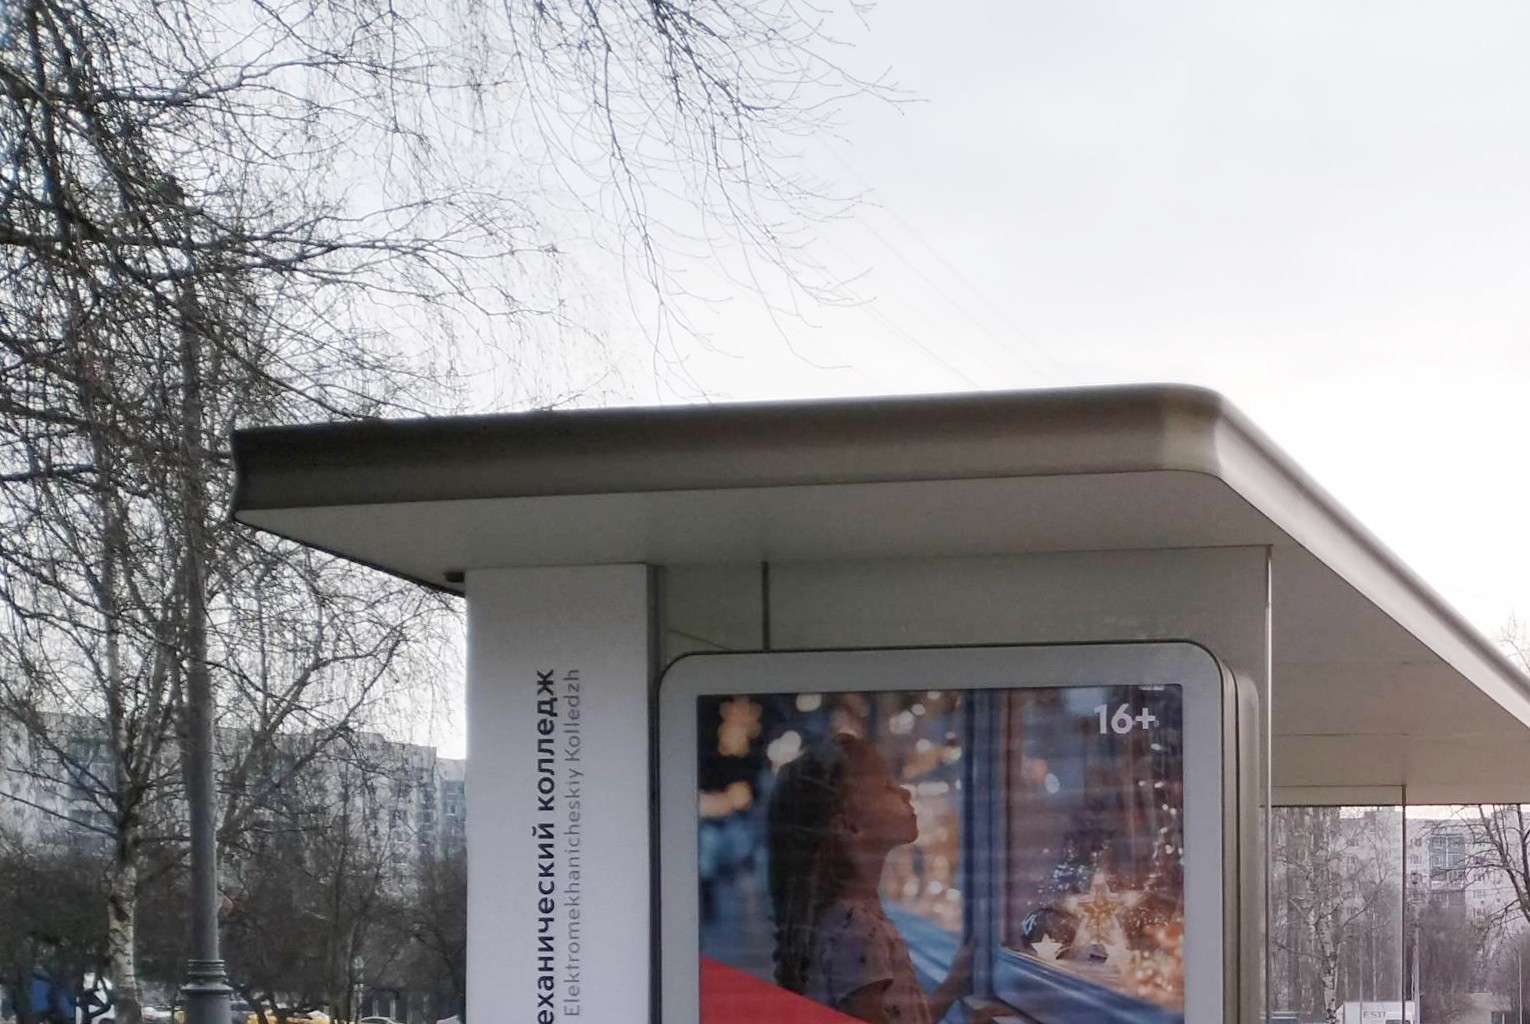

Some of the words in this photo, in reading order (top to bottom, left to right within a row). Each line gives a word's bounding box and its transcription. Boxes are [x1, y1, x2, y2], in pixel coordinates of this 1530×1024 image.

[536, 669, 558, 812] колледж
[563, 668, 582, 762] Kolledzh
[1094, 703, 1156, 735] 16+
[563, 768, 584, 1017] Elektromekhanicheskiy
